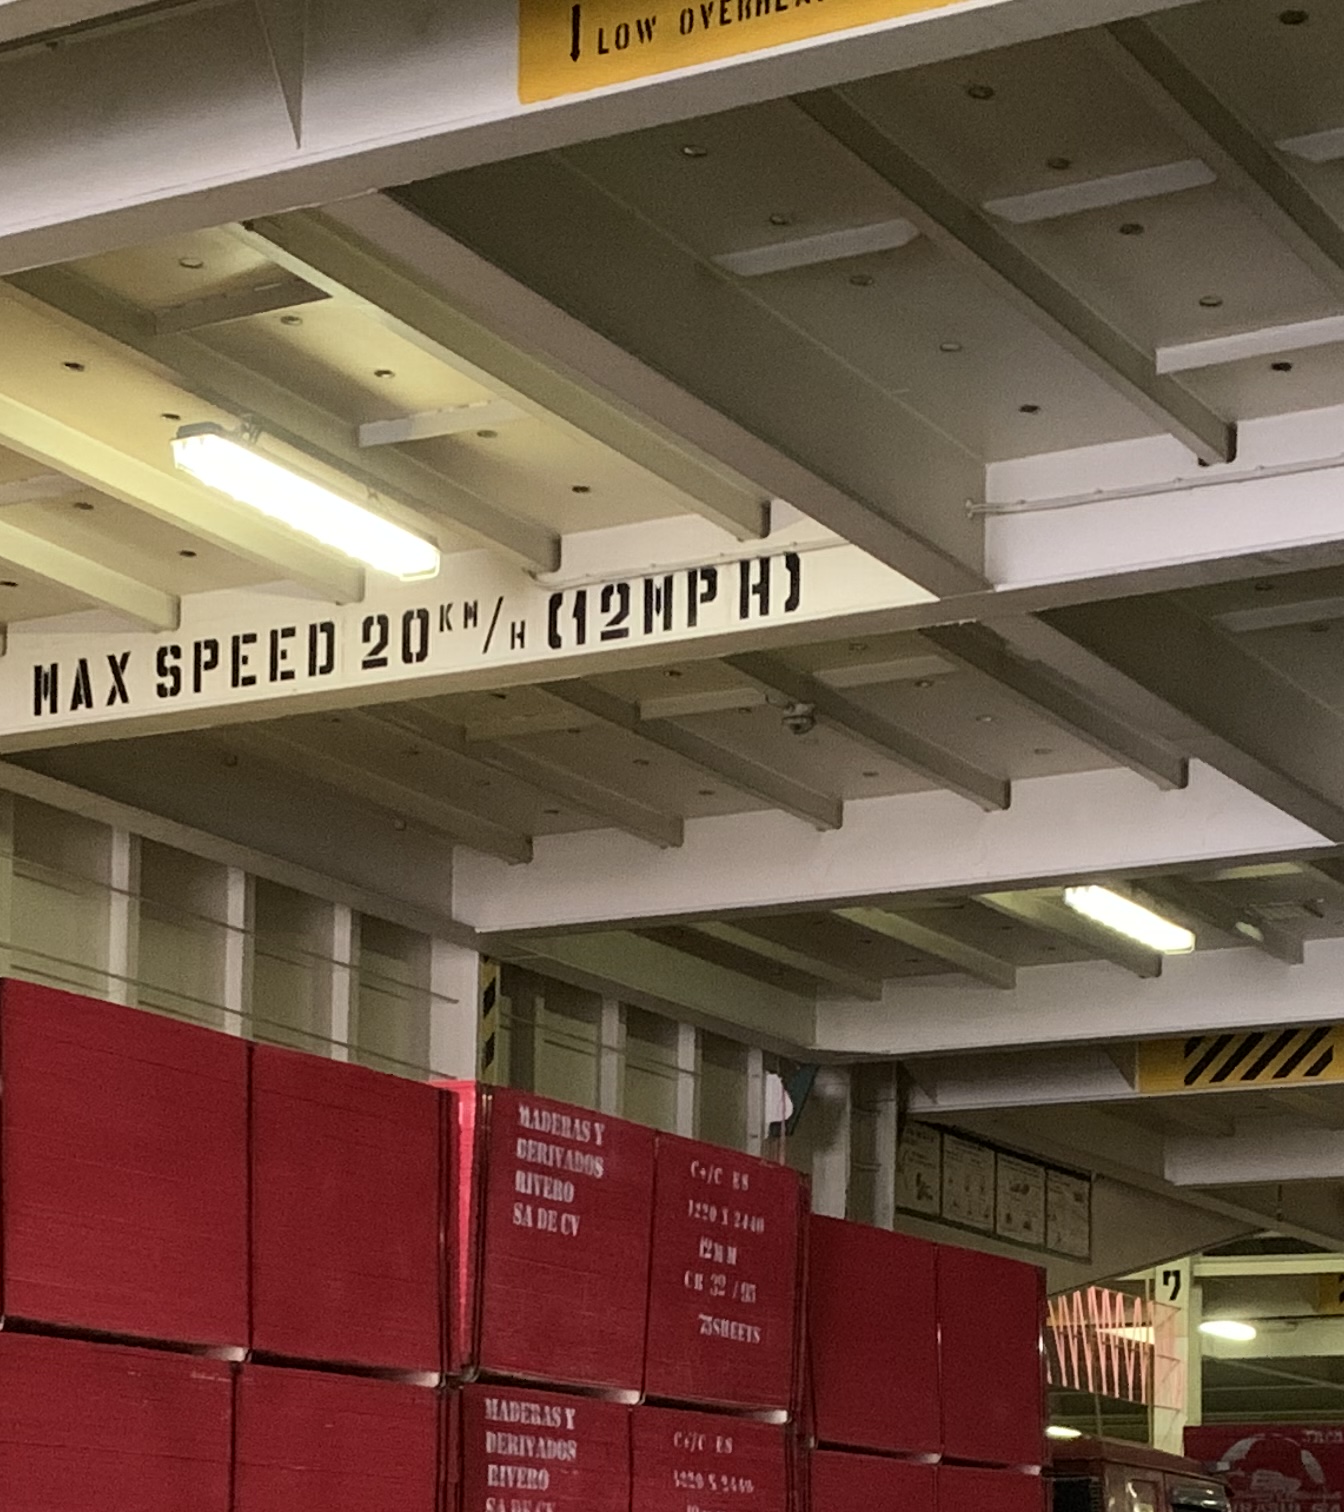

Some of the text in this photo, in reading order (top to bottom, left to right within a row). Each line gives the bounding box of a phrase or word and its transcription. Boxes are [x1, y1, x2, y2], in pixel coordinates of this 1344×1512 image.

[598, 16, 656, 55] LOW
[33, 651, 131, 717] MAX
[157, 620, 335, 699] SPEED
[547, 551, 800, 650] (12MPH)
[519, 1102, 605, 1146] MADERAS Y
[517, 1137, 604, 1179] DERIVADOS
[515, 1170, 574, 1203] RIVERO
[733, 1171, 749, 1191] ES
[513, 1203, 580, 1237] SA DE CV
[688, 1199, 717, 1222] 1220
[485, 1397, 576, 1430] MADERAS Y
[485, 1431, 578, 1461] DERIVADOS
[716, 1435, 733, 1454] ES
[487, 1464, 550, 1491] RIVERO
